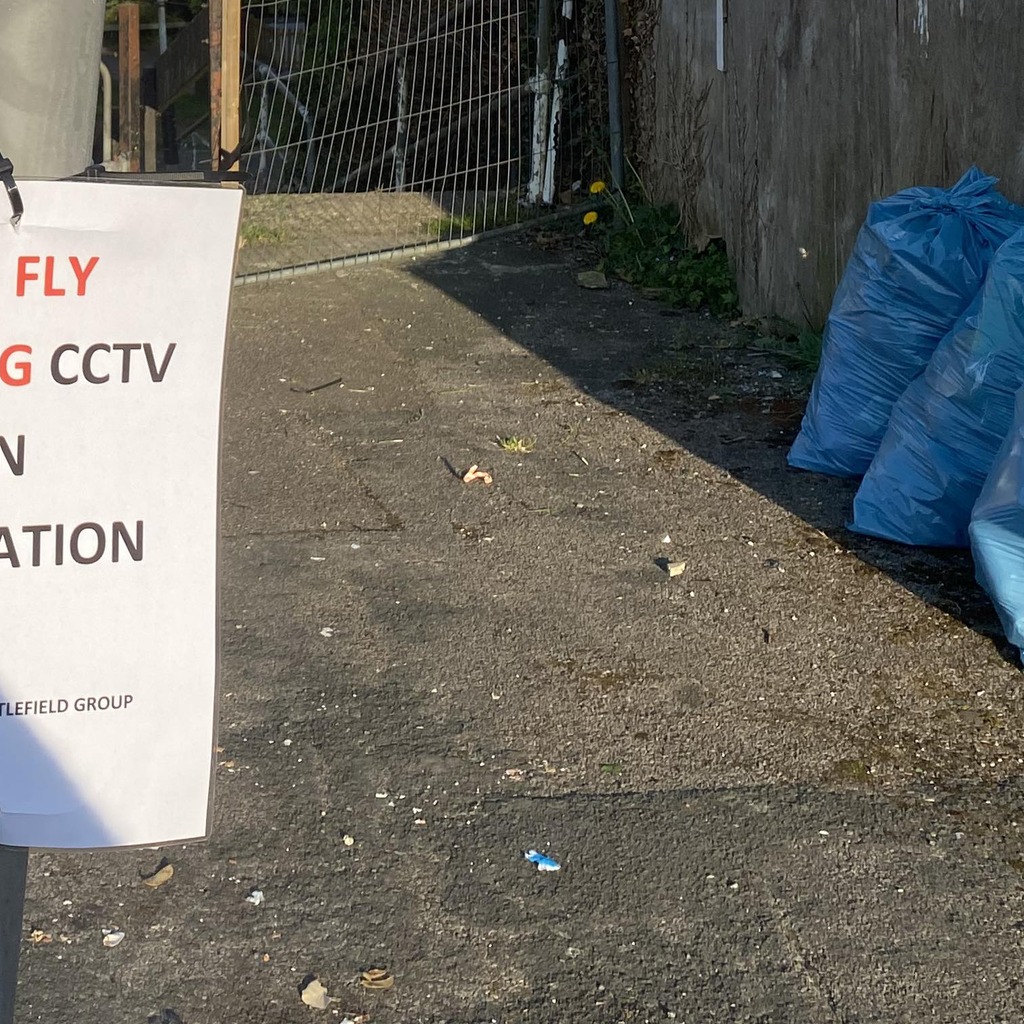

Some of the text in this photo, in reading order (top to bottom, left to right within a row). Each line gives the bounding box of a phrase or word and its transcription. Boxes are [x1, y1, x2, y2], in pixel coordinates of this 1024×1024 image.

[15, 255, 100, 298] FLY
[50, 342, 177, 386] CCTV
[73, 694, 134, 713] GROUP
